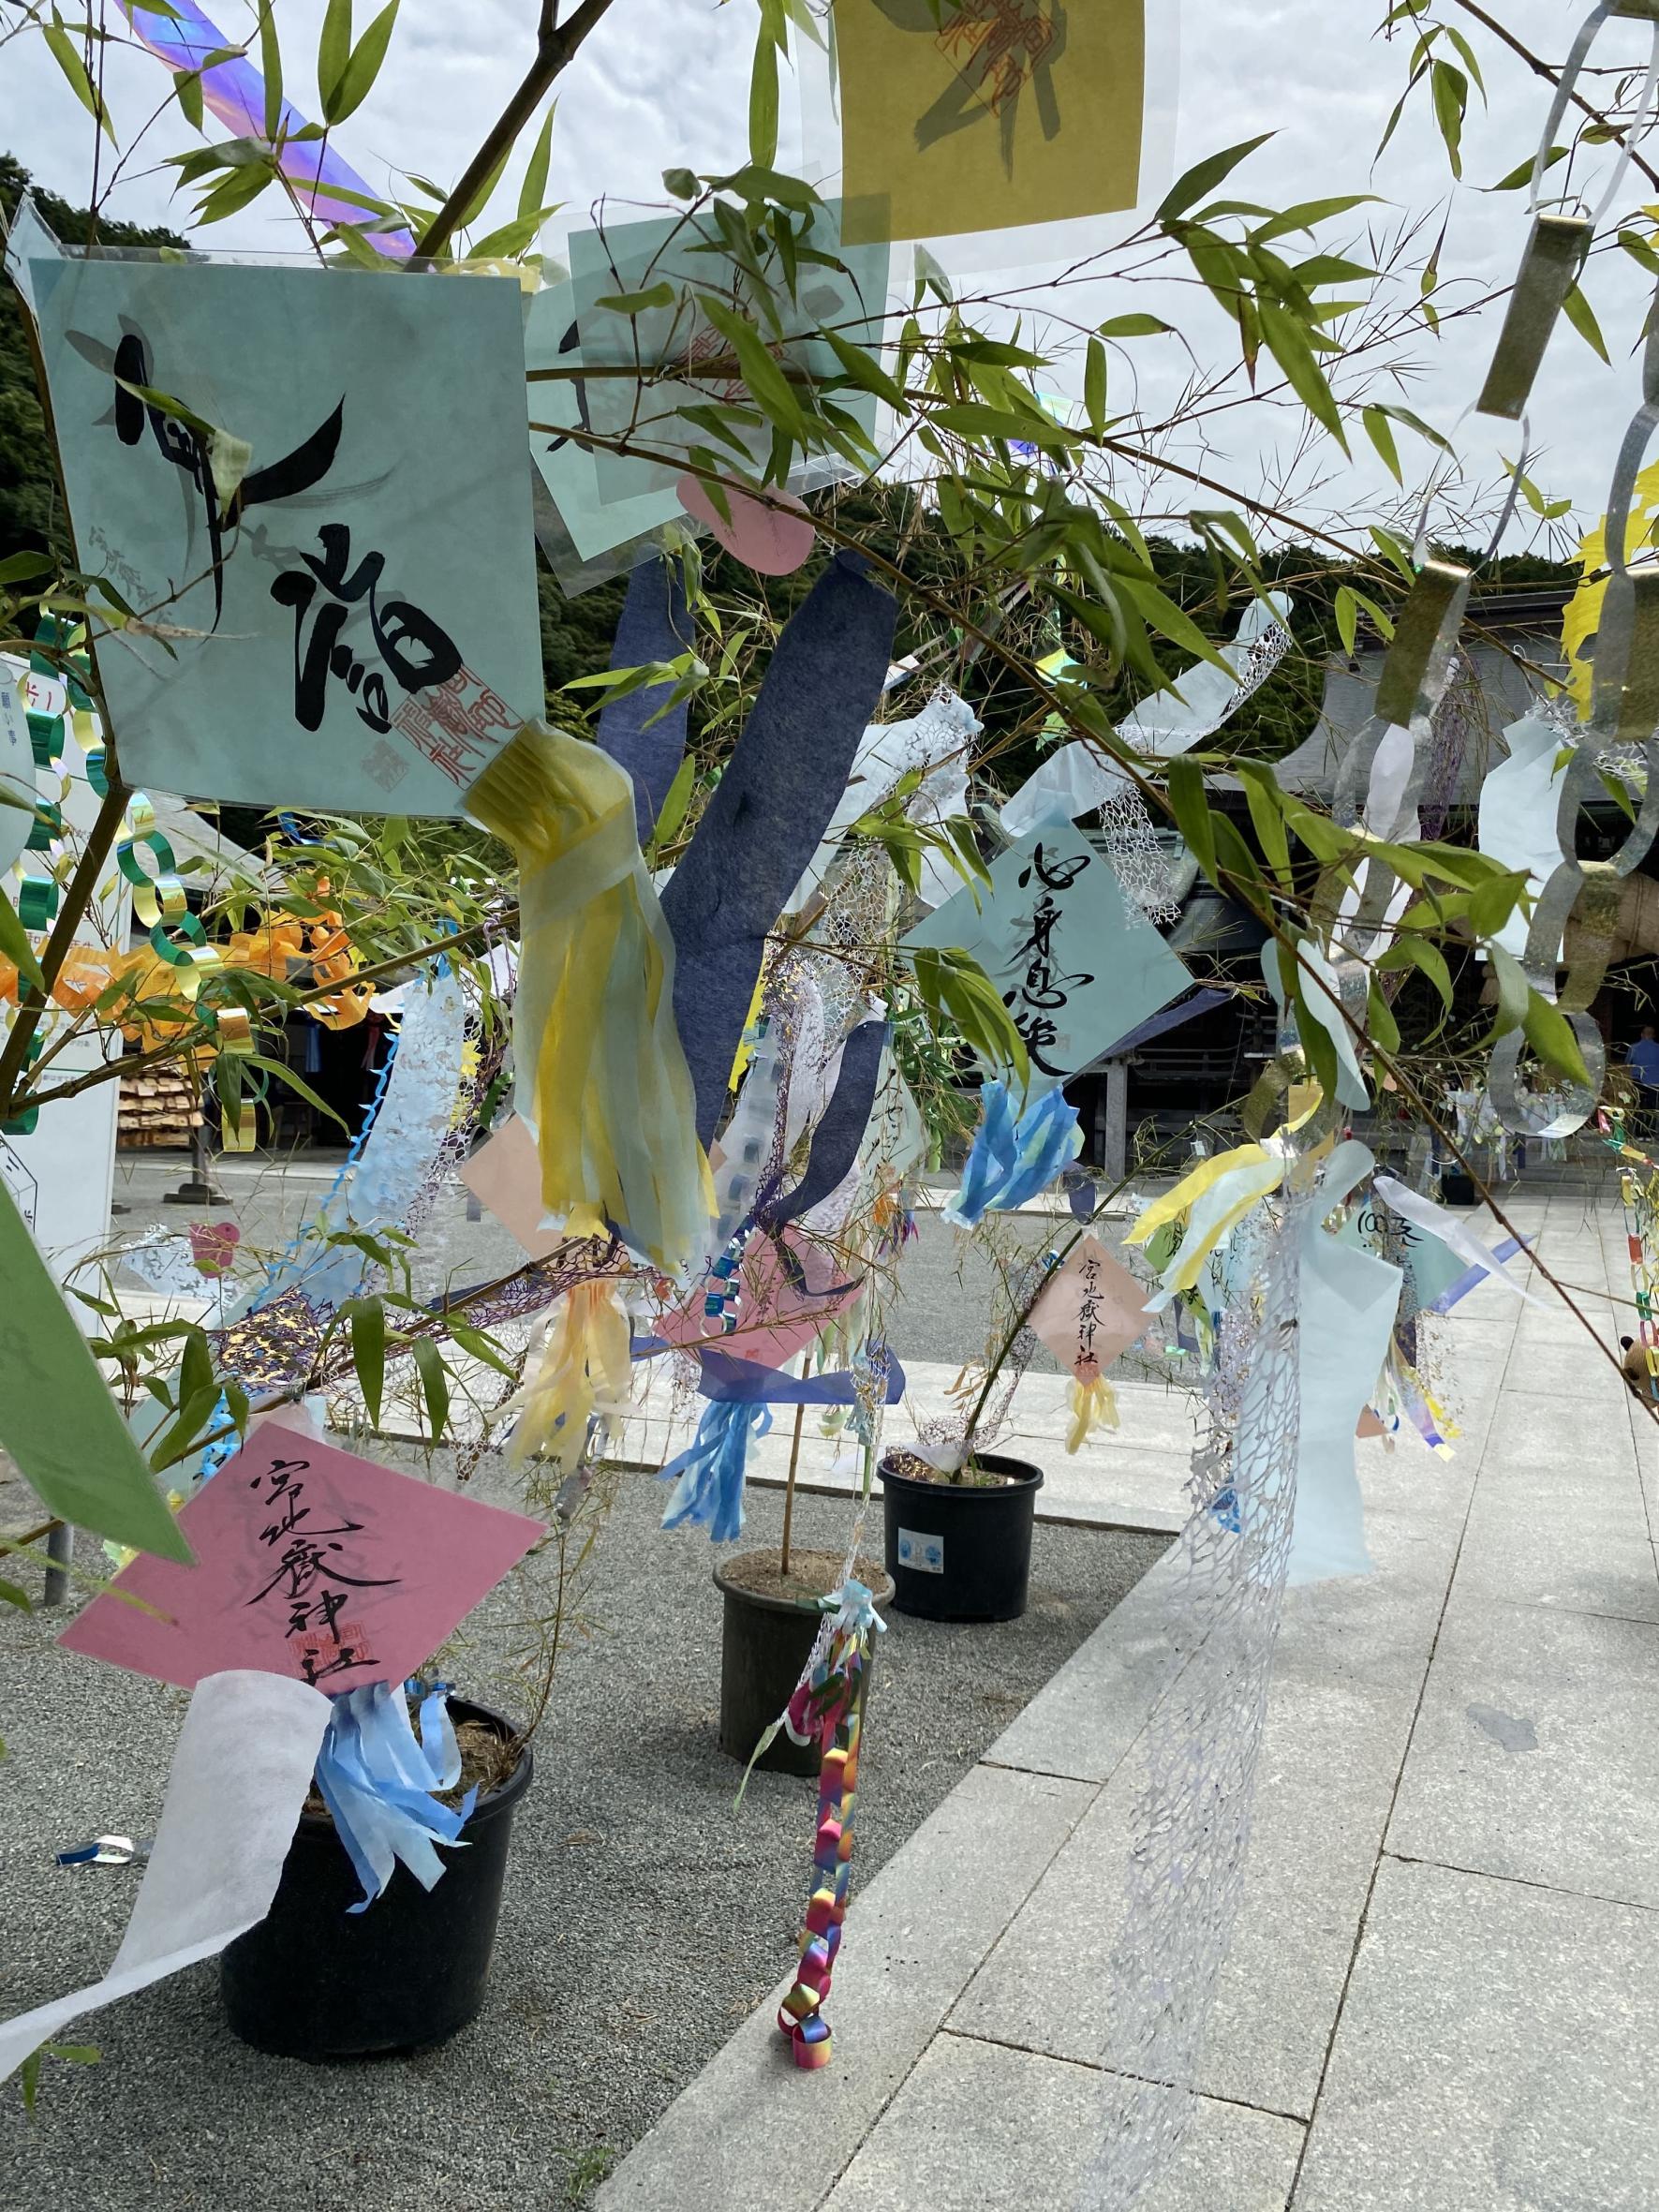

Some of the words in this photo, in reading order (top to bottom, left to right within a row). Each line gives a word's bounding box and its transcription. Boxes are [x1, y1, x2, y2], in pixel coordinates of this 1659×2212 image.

[1072, 1260, 1105, 1365] 宮地嶽神社
[244, 1460, 403, 1685] 宮地嶽神社
